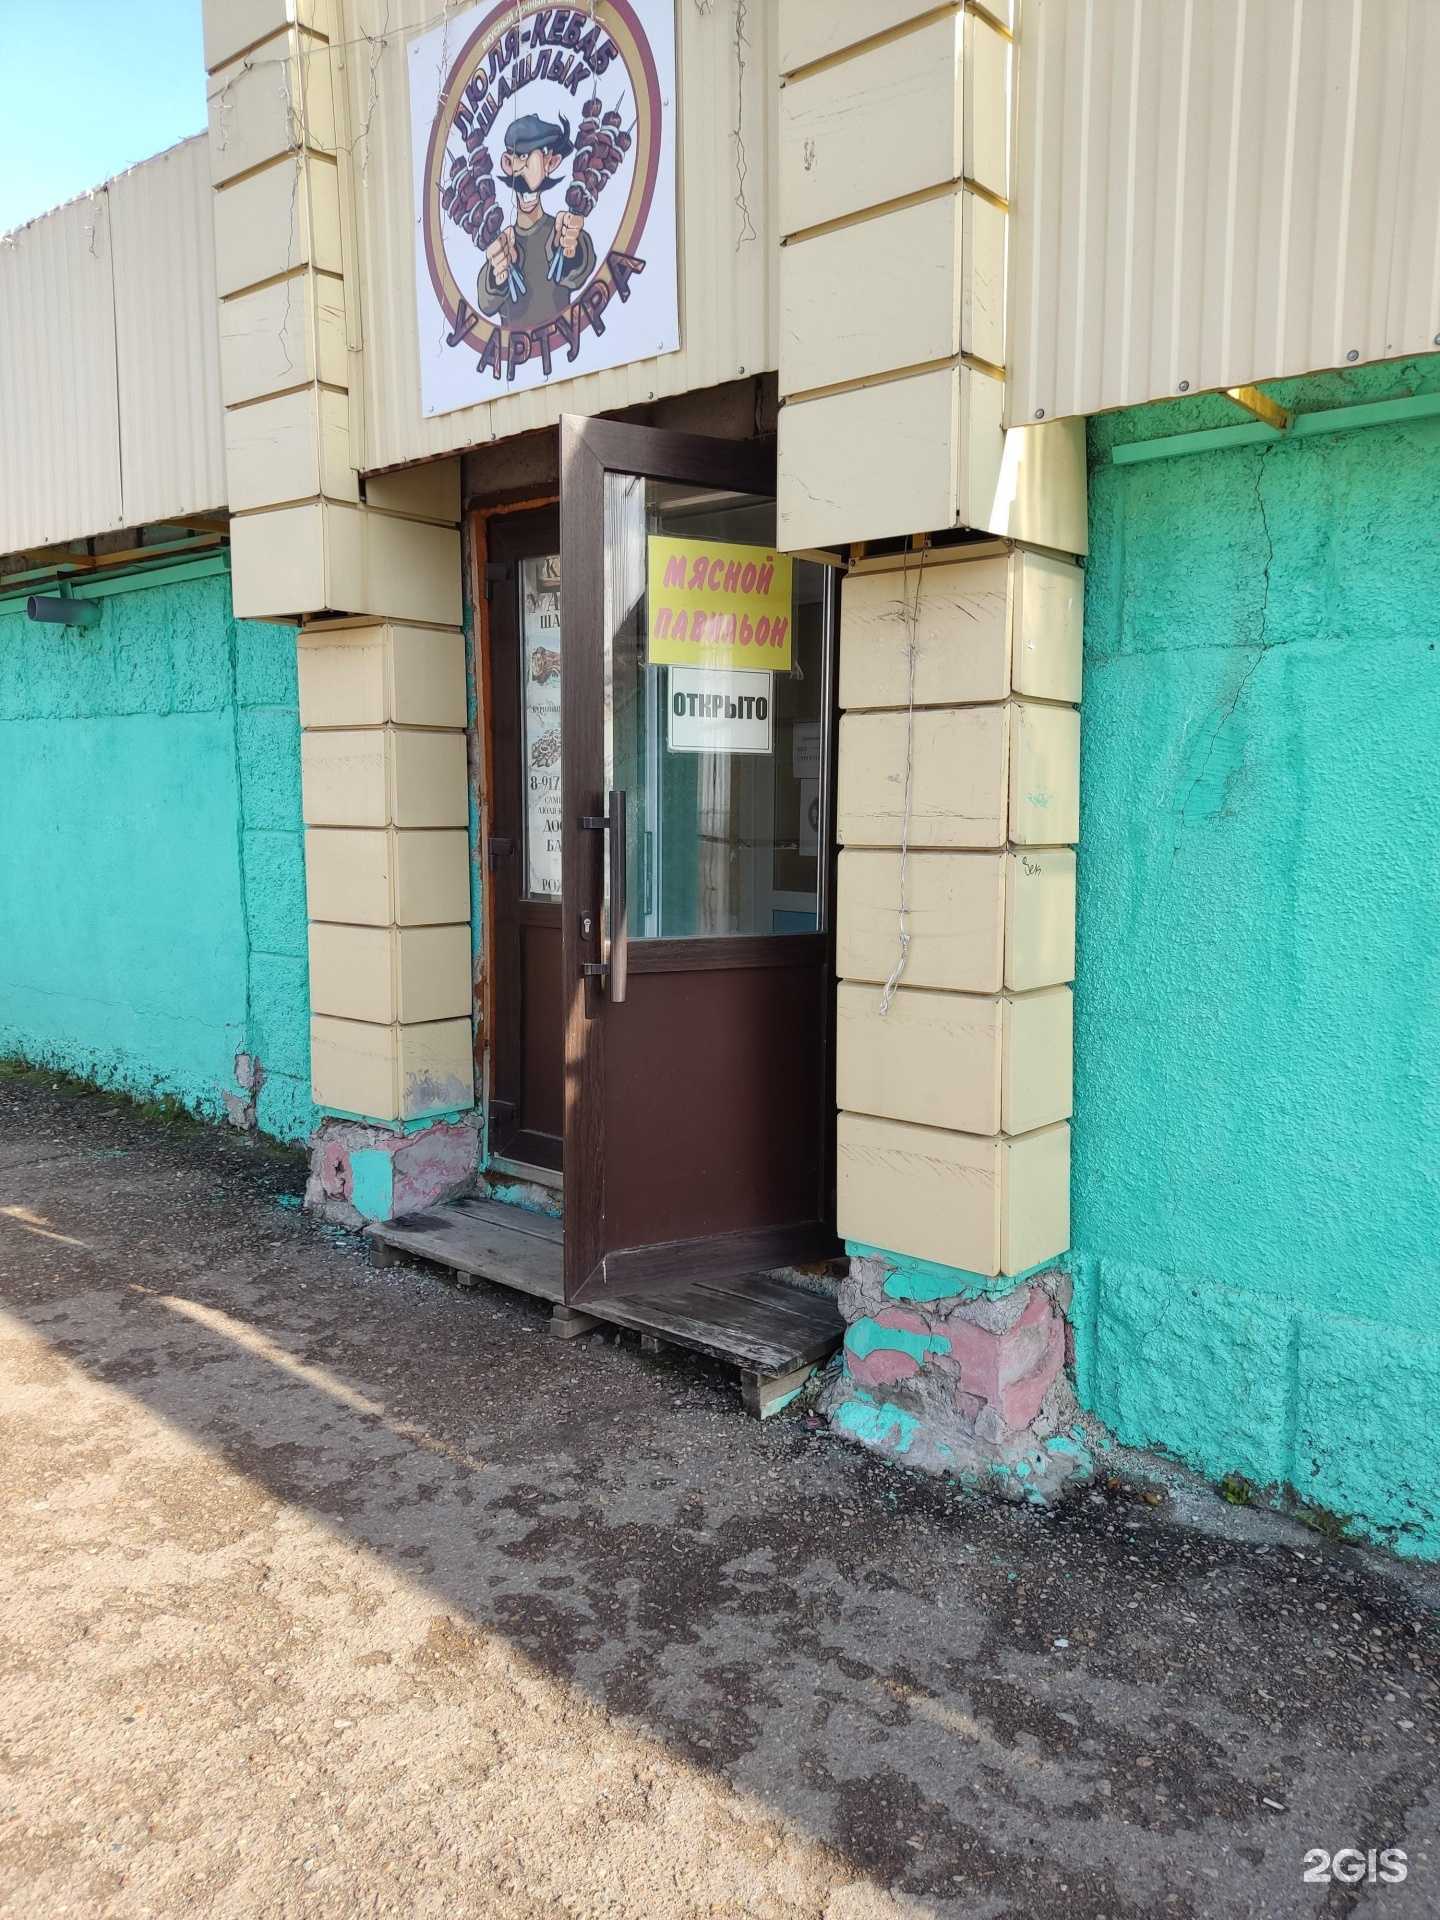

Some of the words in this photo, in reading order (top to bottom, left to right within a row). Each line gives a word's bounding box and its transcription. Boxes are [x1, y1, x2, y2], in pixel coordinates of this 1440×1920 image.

[454, 9, 619, 142] ЛЮЛЯ-КЕБАБ
[476, 49, 591, 137] ШАШЛЫК
[446, 298, 478, 347] У
[476, 251, 646, 381] АРТУРА
[663, 555, 775, 595] МЯСНОЙ
[654, 607, 789, 648] ПАВИЛЬОН
[673, 692, 768, 720] ОТКРЫТО
